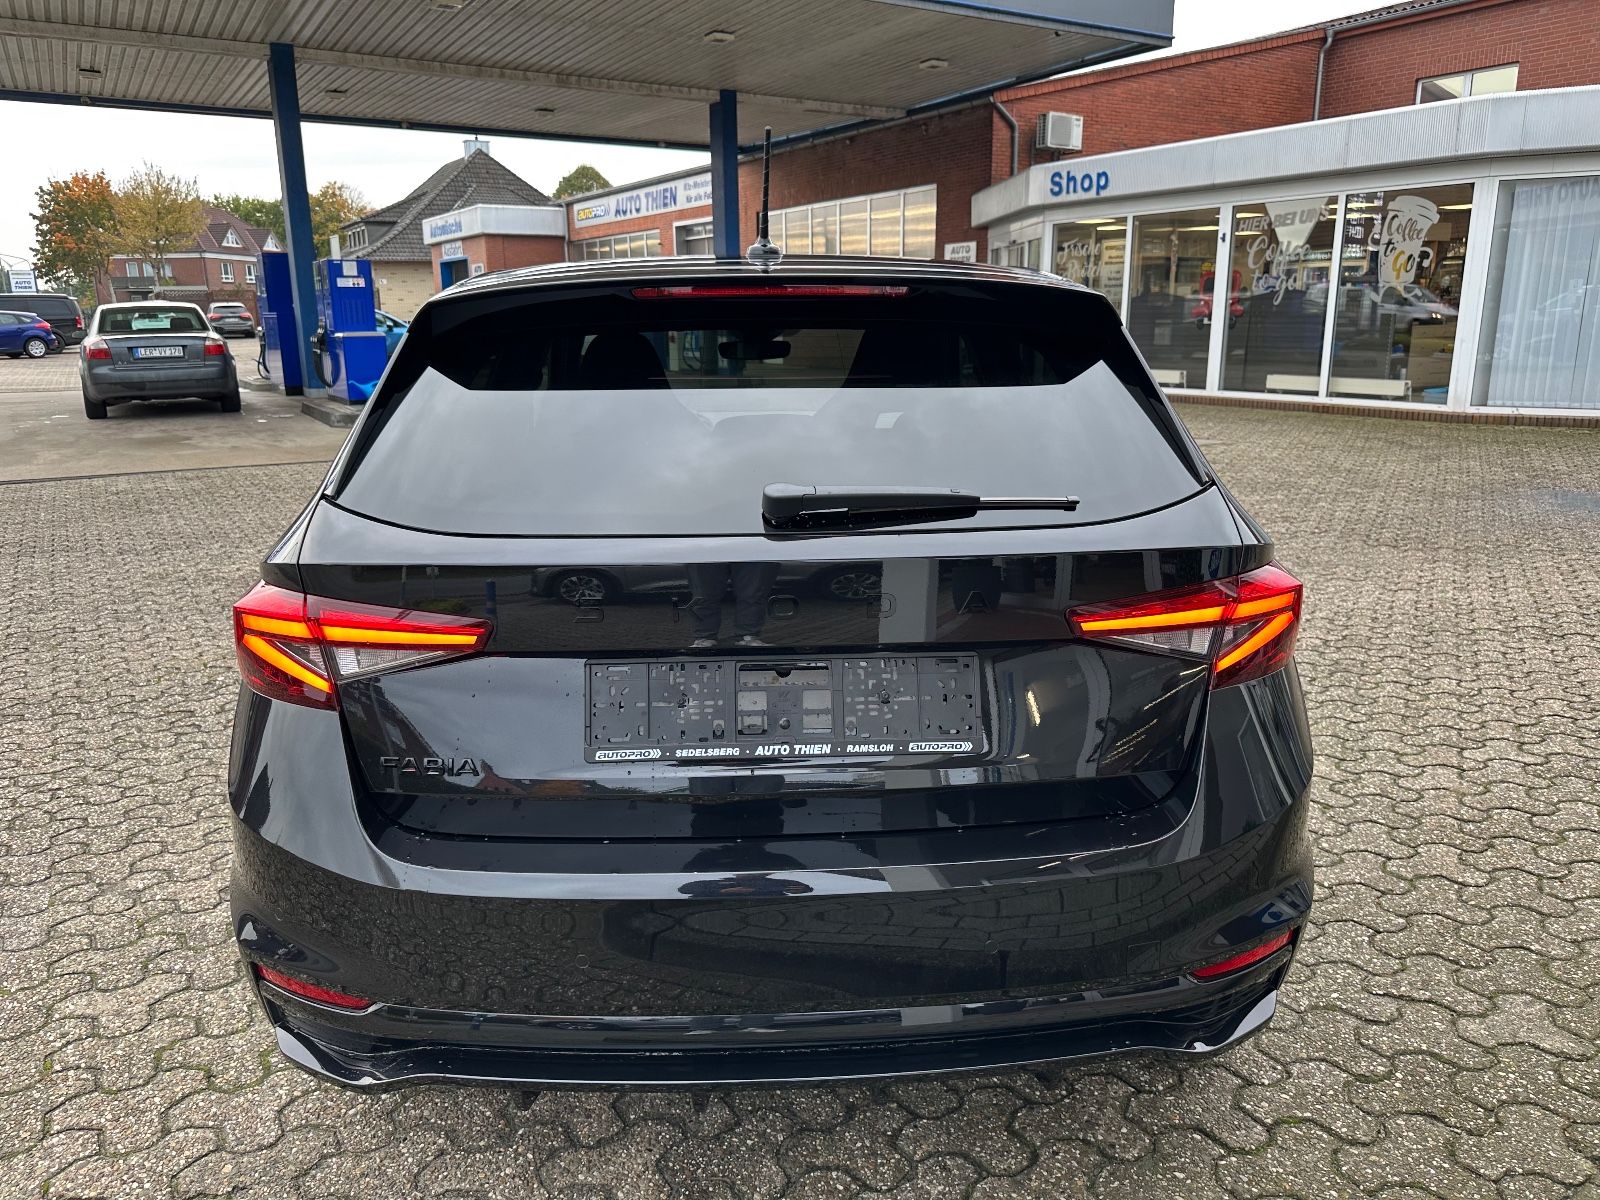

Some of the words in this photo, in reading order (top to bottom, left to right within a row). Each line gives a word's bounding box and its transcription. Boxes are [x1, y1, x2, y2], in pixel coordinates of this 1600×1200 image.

[1050, 171, 1109, 197] Shop
[614, 193, 641, 218] AUTO
[645, 185, 678, 213] THIEN
[1238, 216, 1270, 232] HIER
[1273, 211, 1298, 228] BEI
[1298, 204, 1330, 224] UNS
[1386, 213, 1424, 242] Coffee
[950, 244, 971, 256] AUTO
[1246, 235, 1311, 276] Coffee
[1382, 237, 1397, 258] to
[1250, 269, 1271, 291] to
[1272, 273, 1298, 306] go
[675, 748, 740, 757] SEDELSBERG
[754, 745, 790, 756] AUTO
[793, 744, 832, 755] THIEN
[846, 744, 894, 753] RAMSLOH
[380, 756, 480, 777] FABIA
